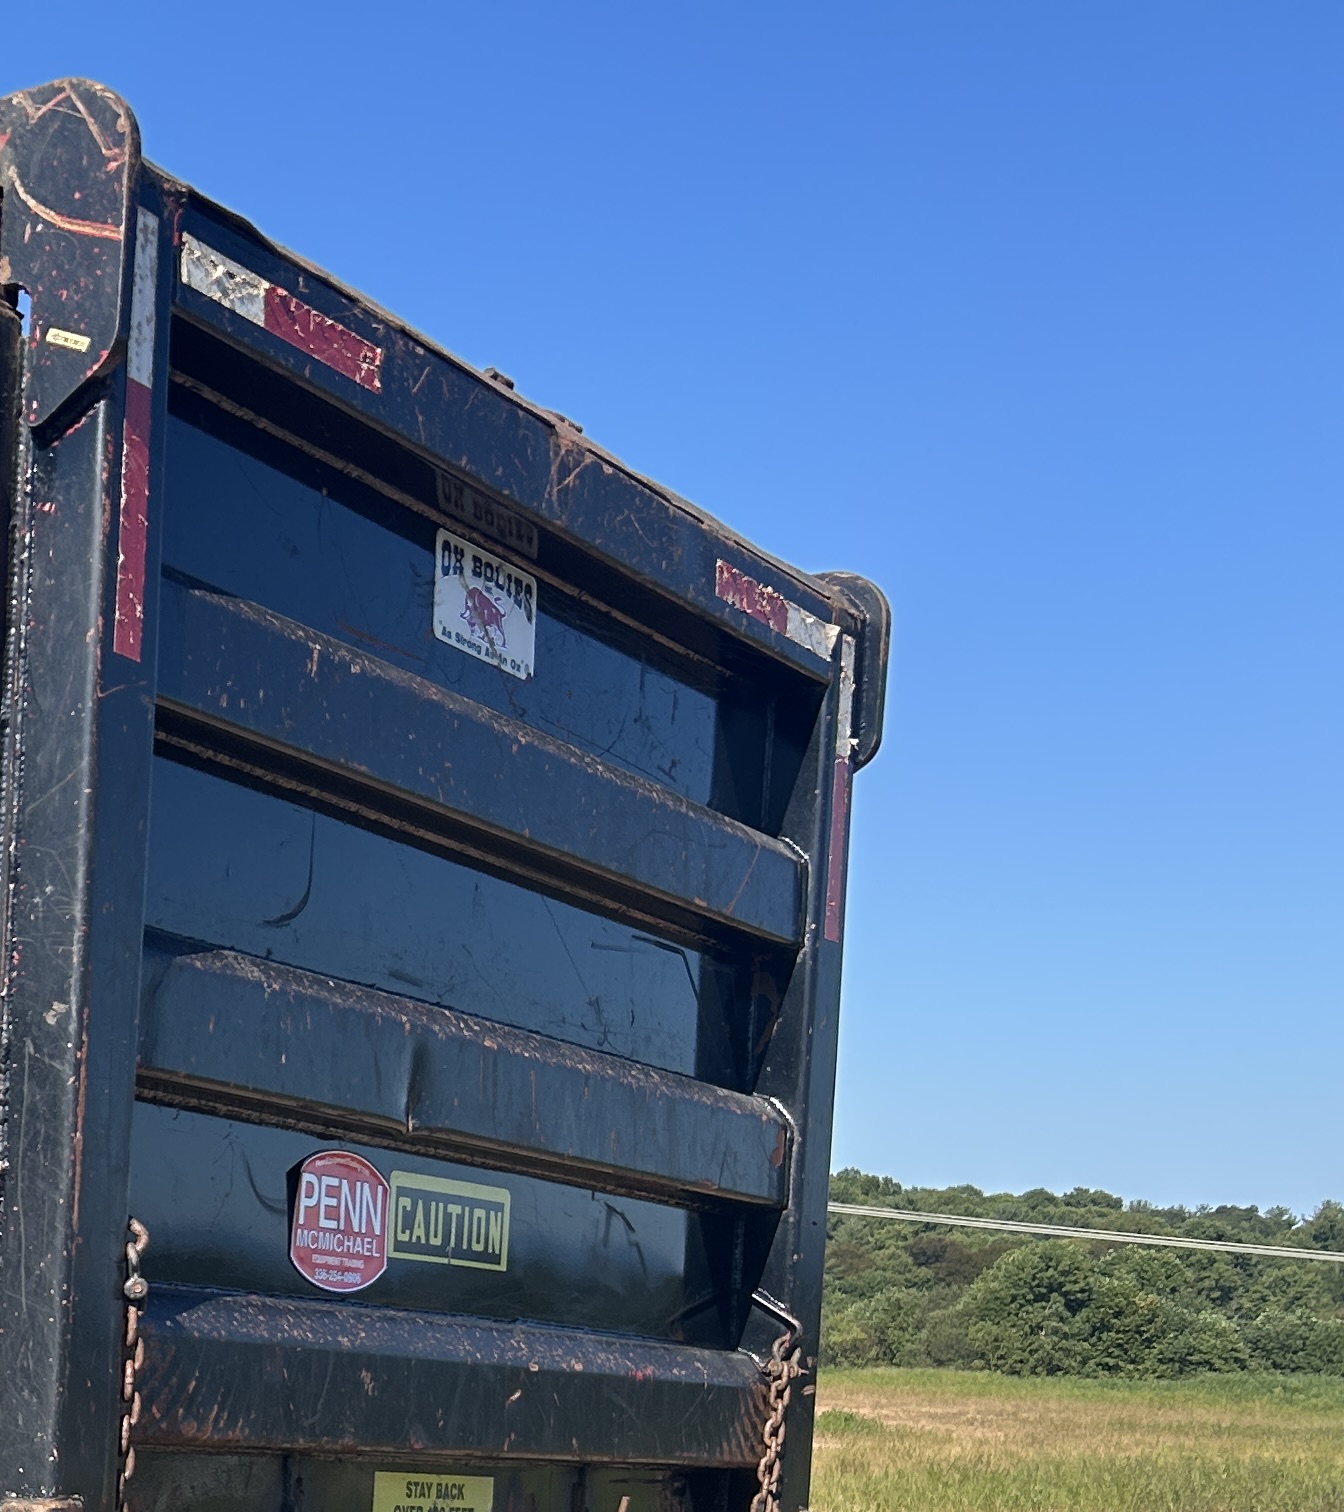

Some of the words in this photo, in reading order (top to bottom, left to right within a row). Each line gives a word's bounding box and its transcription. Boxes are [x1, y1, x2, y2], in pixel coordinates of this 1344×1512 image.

[441, 539, 465, 577] OX
[455, 631, 482, 656] Strong
[298, 1172, 383, 1236] PENN
[396, 1196, 502, 1255] CAUTION
[296, 1228, 381, 1258] MCMICHAEL
[405, 1480, 434, 1499] STAY
[435, 1482, 465, 1500] BACK
